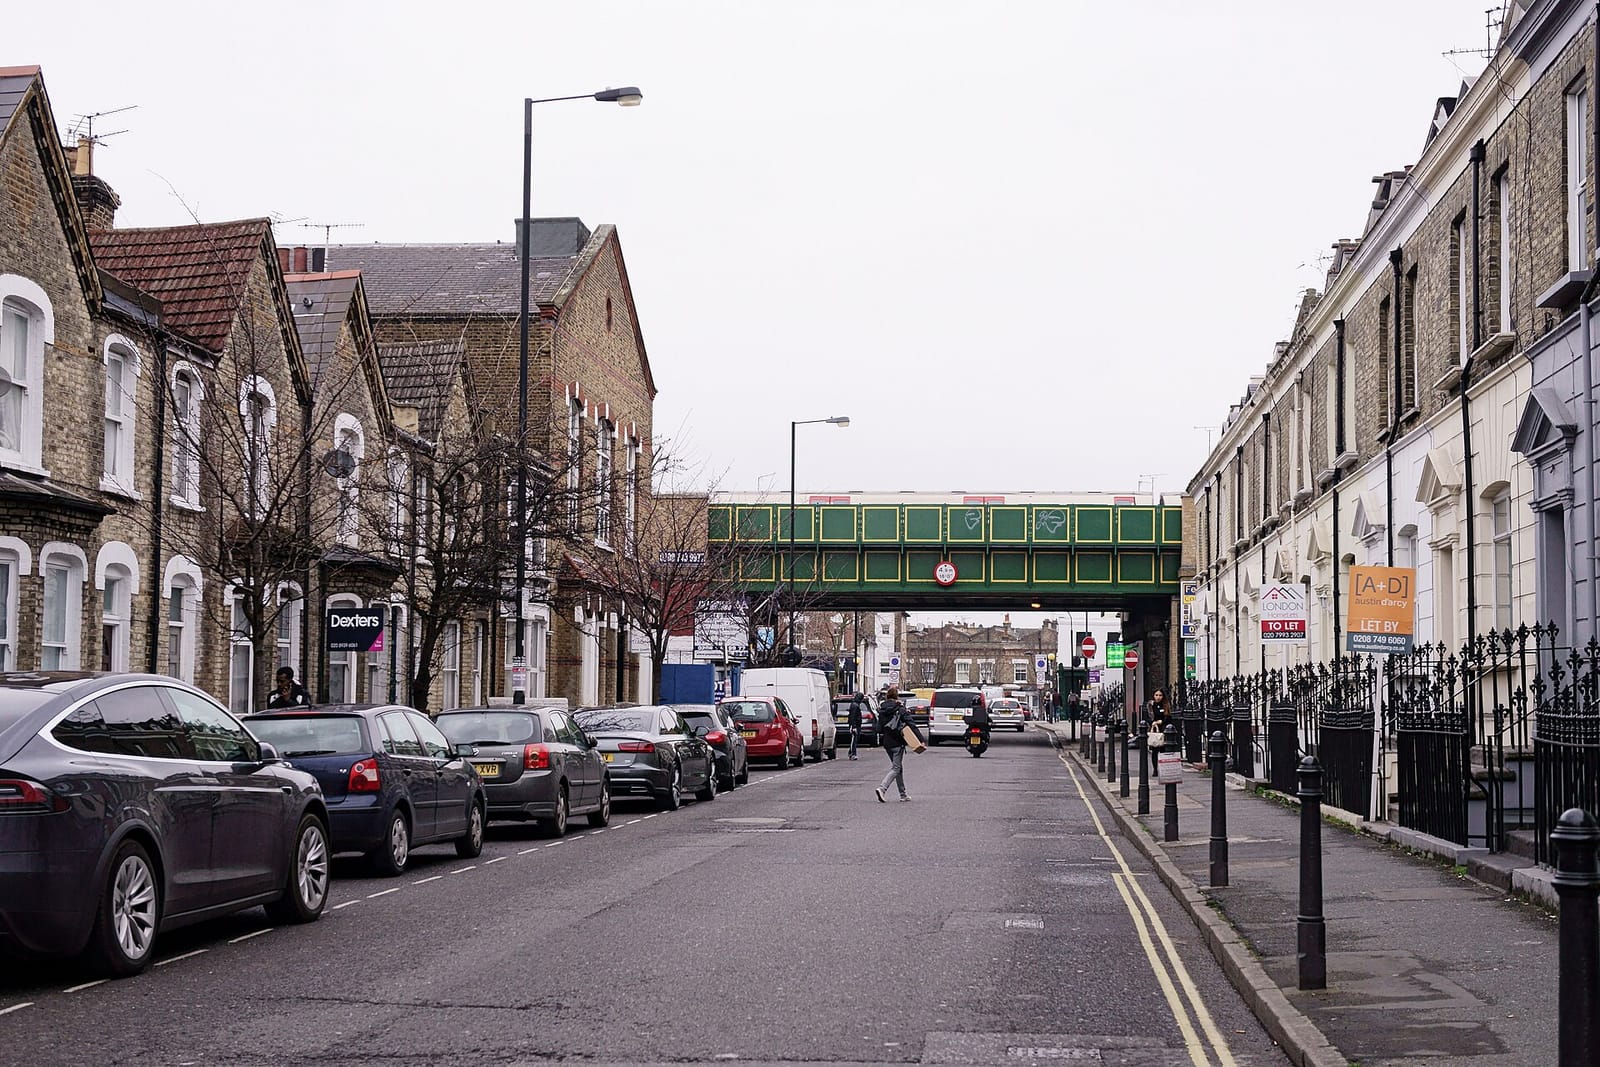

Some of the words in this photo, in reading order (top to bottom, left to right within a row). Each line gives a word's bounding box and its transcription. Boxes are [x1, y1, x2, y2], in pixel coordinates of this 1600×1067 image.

[1262, 602, 1304, 611] LONDON
[331, 613, 380, 628] Dexters
[1268, 622, 1282, 631] TO
[1284, 622, 1299, 631] LET
[1360, 619, 1381, 632] LET
[1384, 621, 1399, 633] BY
[1353, 634, 1371, 643] 0208
[1373, 635, 1387, 644] 749
[1388, 636, 1406, 645] 6060
[480, 765, 497, 774] XVR
